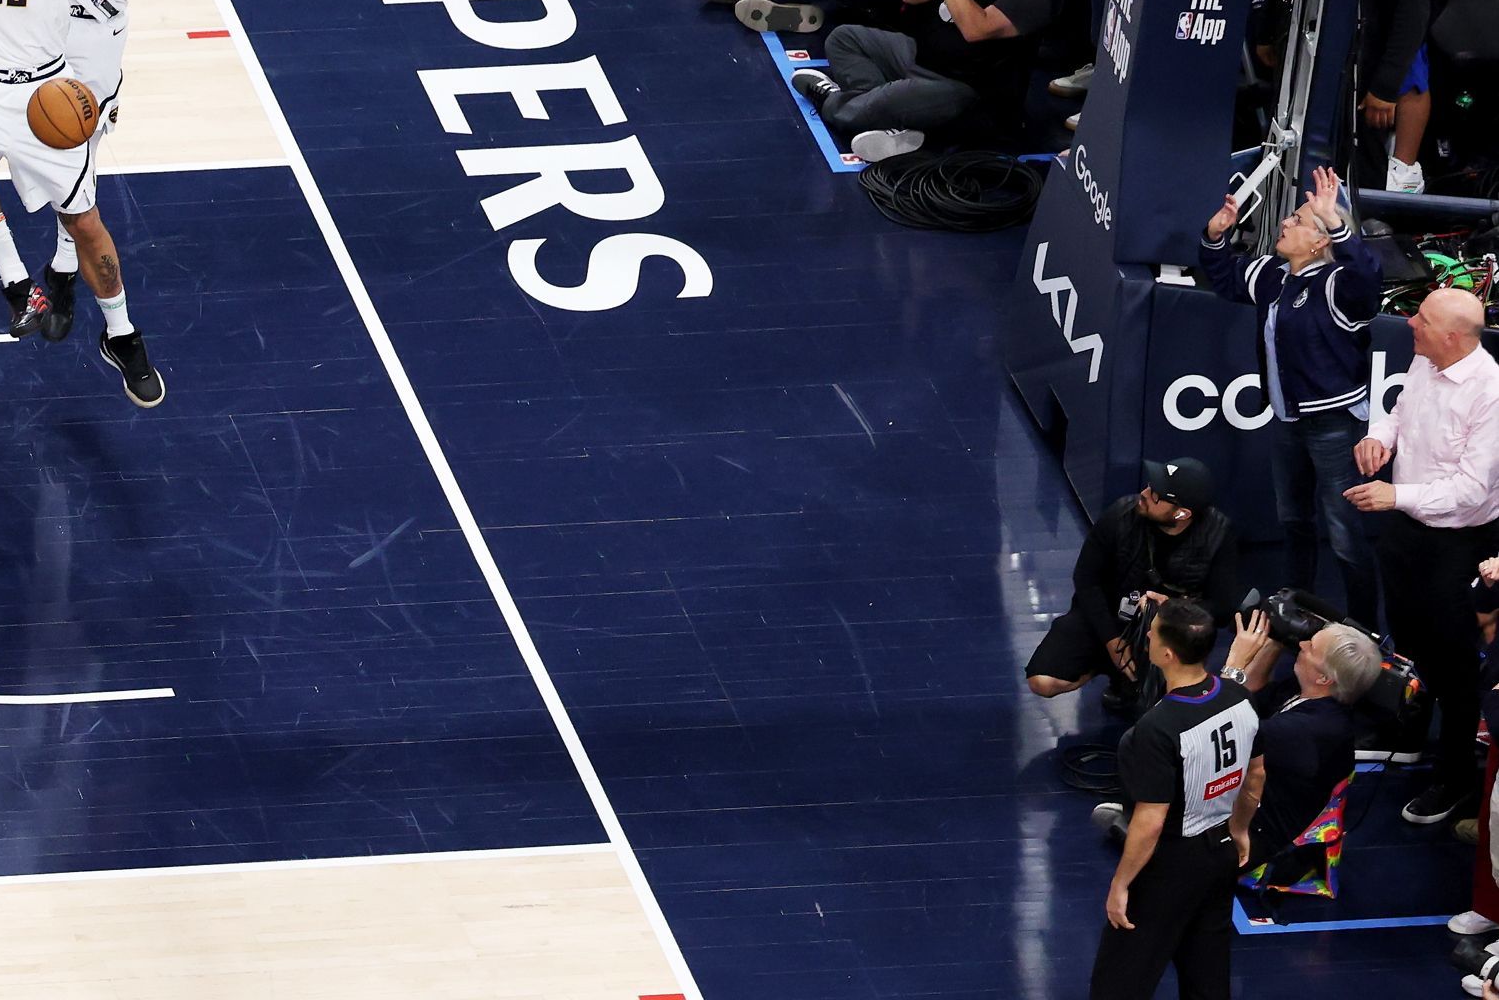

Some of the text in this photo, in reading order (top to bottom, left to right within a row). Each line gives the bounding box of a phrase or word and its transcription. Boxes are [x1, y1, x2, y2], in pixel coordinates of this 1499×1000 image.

[1110, 14, 1131, 84] App
[1190, 13, 1226, 45] App
[1075, 145, 1112, 231] Google
[1210, 721, 1237, 773] 15
[1208, 776, 1240, 795] Emirates
